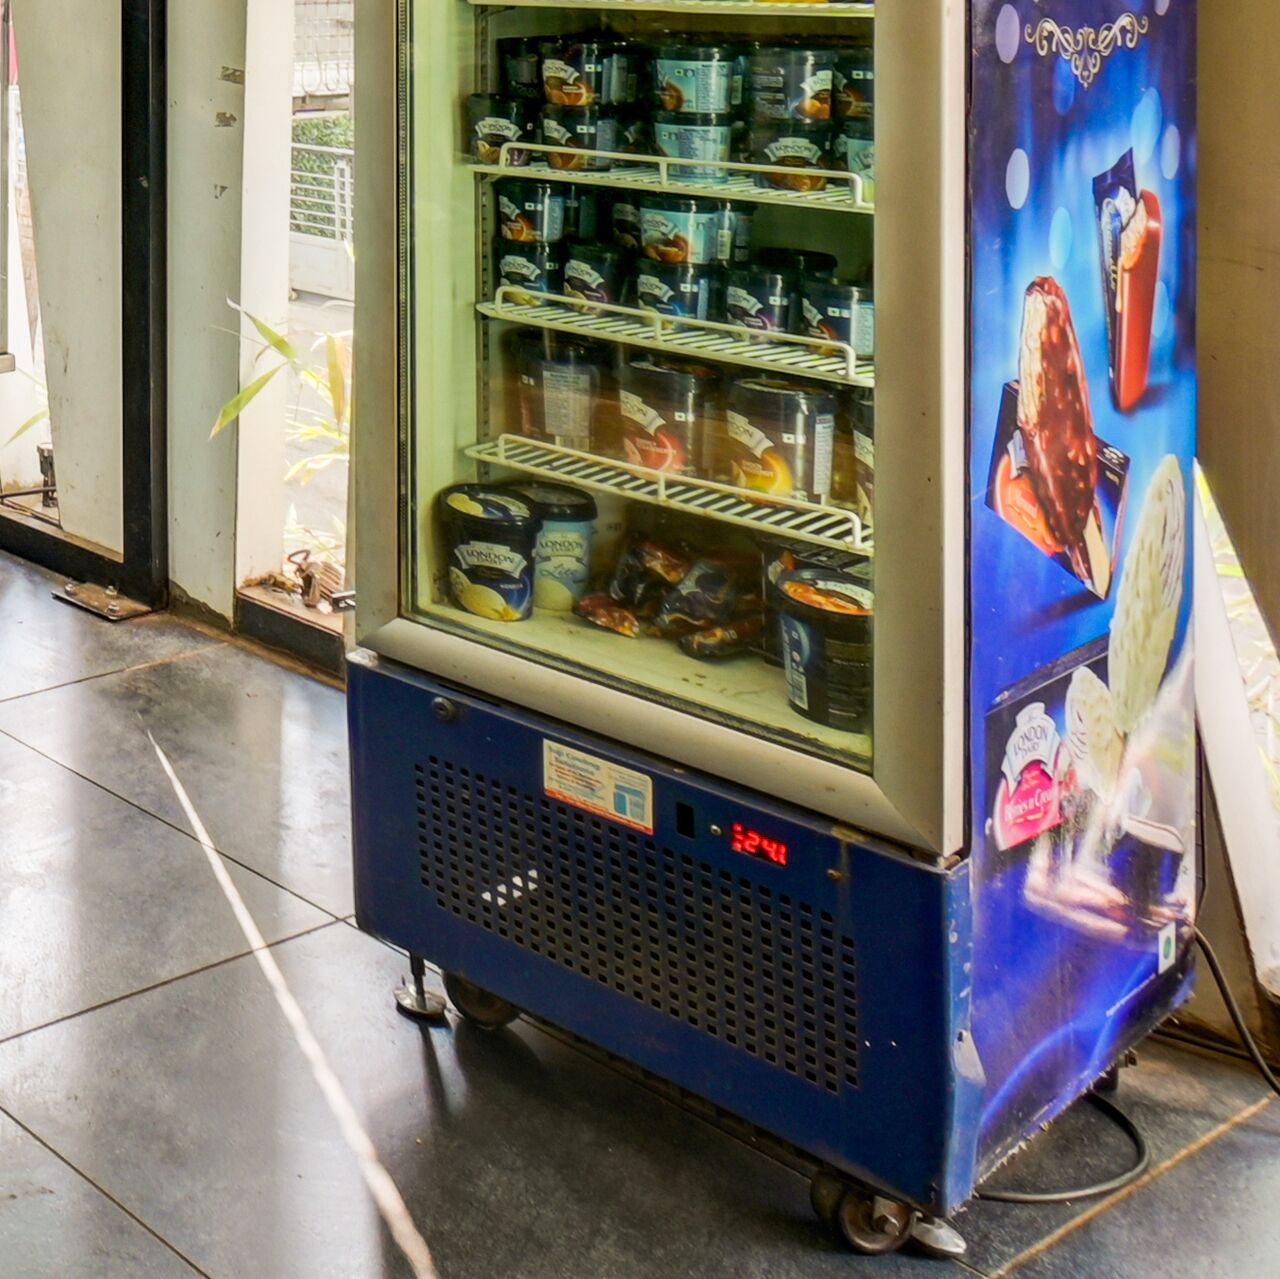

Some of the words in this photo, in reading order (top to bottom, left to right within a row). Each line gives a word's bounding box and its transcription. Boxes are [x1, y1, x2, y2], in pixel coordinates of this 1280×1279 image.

[539, 540, 584, 550] LONDON
[465, 549, 514, 563] LONDON
[1013, 724, 1049, 756] LONDON
